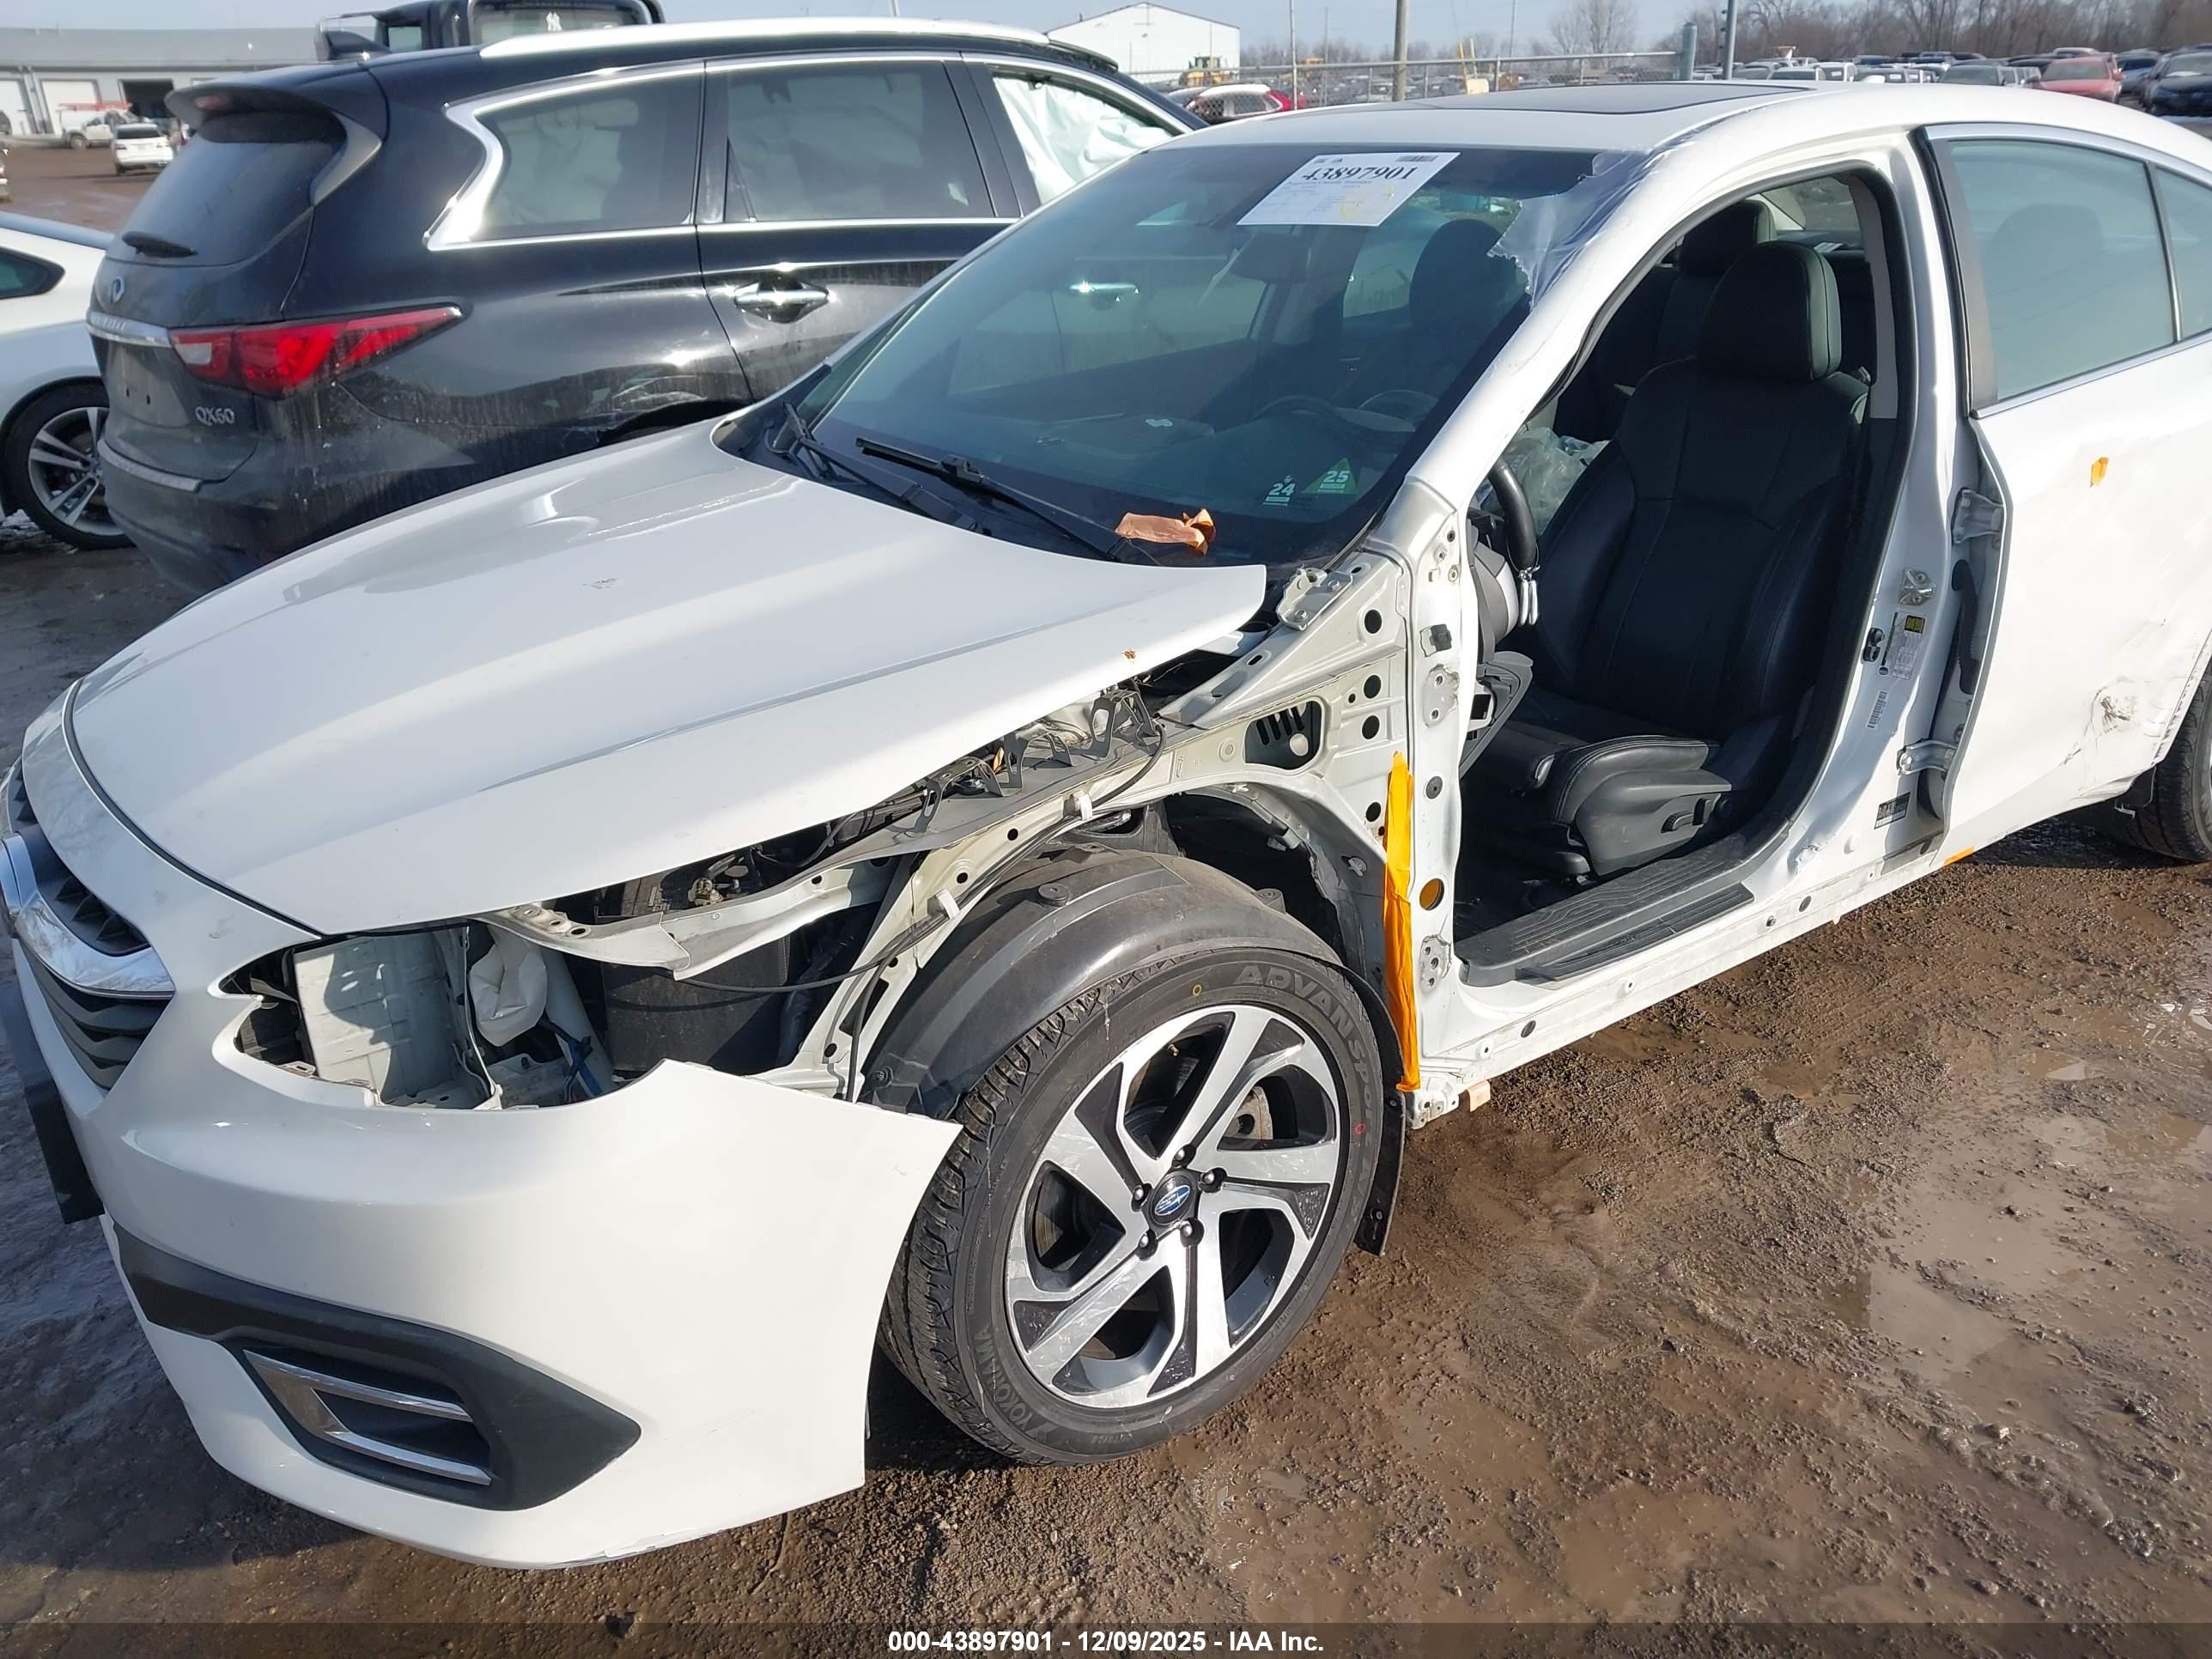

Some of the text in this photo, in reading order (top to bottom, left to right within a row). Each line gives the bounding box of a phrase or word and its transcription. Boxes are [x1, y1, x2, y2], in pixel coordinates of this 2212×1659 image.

[1302, 166, 1419, 180] 43897901
[194, 406, 234, 426] QX60
[1323, 470, 1351, 483] 25
[1268, 483, 1296, 496] 24
[1233, 965, 1354, 1038] ADVAN
[973, 1325, 1033, 1432] YOKOHAMA
